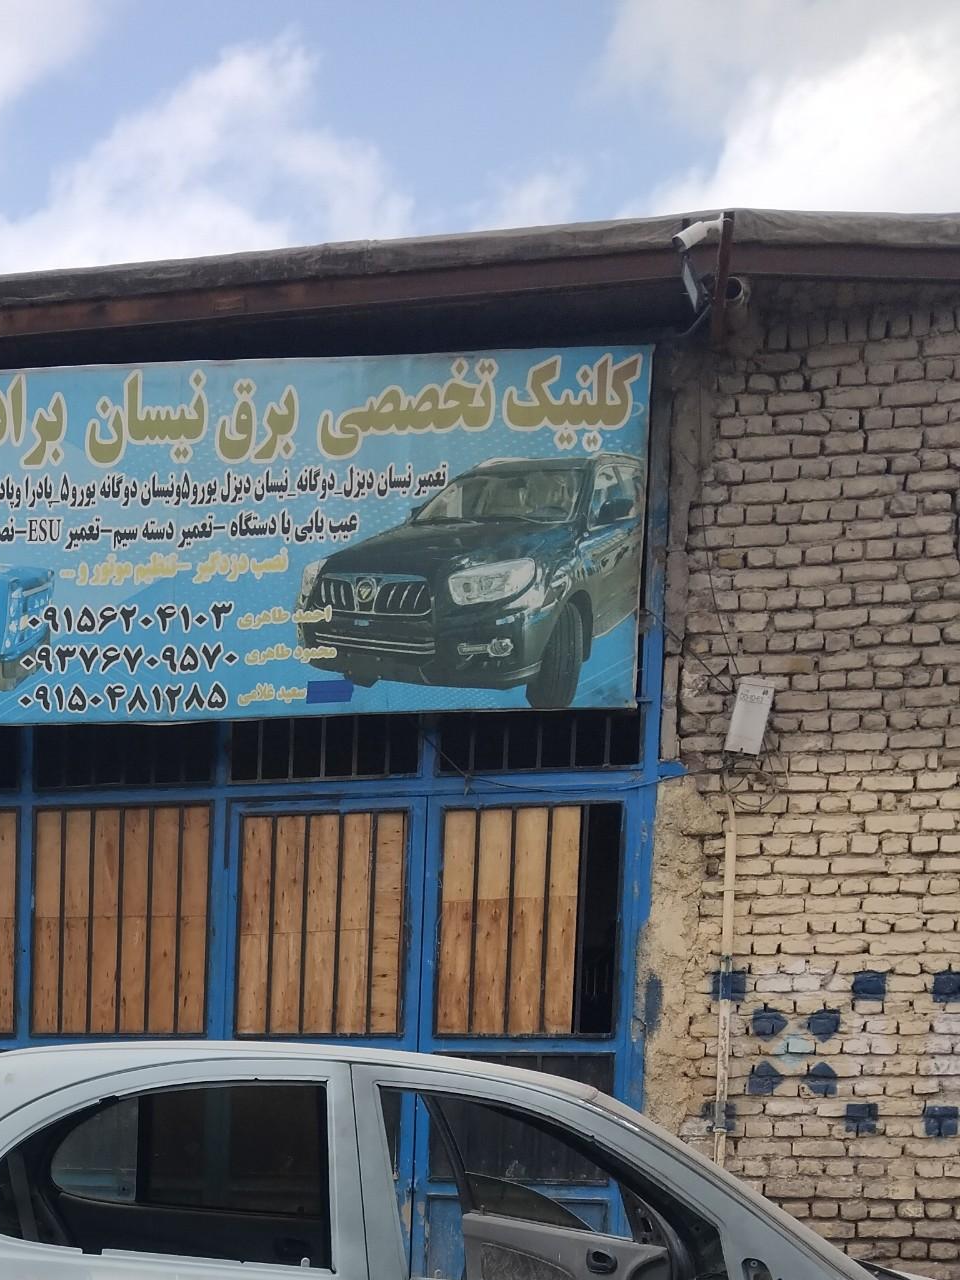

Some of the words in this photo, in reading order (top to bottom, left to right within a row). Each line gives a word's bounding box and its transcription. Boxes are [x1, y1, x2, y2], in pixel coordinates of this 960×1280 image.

[320, 361, 494, 457] تخصصی
[507, 356, 639, 448] کلینیک
[87, 371, 207, 466] نیسان
[217, 380, 297, 461] برق
[100, 475, 138, 506] دوگانه
[221, 471, 251, 503] دیزل
[378, 464, 412, 497] نیسان
[415, 464, 447, 497] تعمیر
[142, 519, 174, 541] دسته
[230, 512, 277, 537] دستگاه
[281, 511, 290, 541] با
[295, 509, 325, 542] یابی
[329, 513, 359, 540] عیب
[251, 548, 288, 578] نصب
[28, 601, 234, 633] ۰۹۱۵۶۲۰۴۱۰۳
[20, 643, 238, 673] ۰۹۳۷۶۷۰۹۵۷۰
[19, 682, 227, 713] ۰۹۱۵۰۴۸۱۲۸۵
